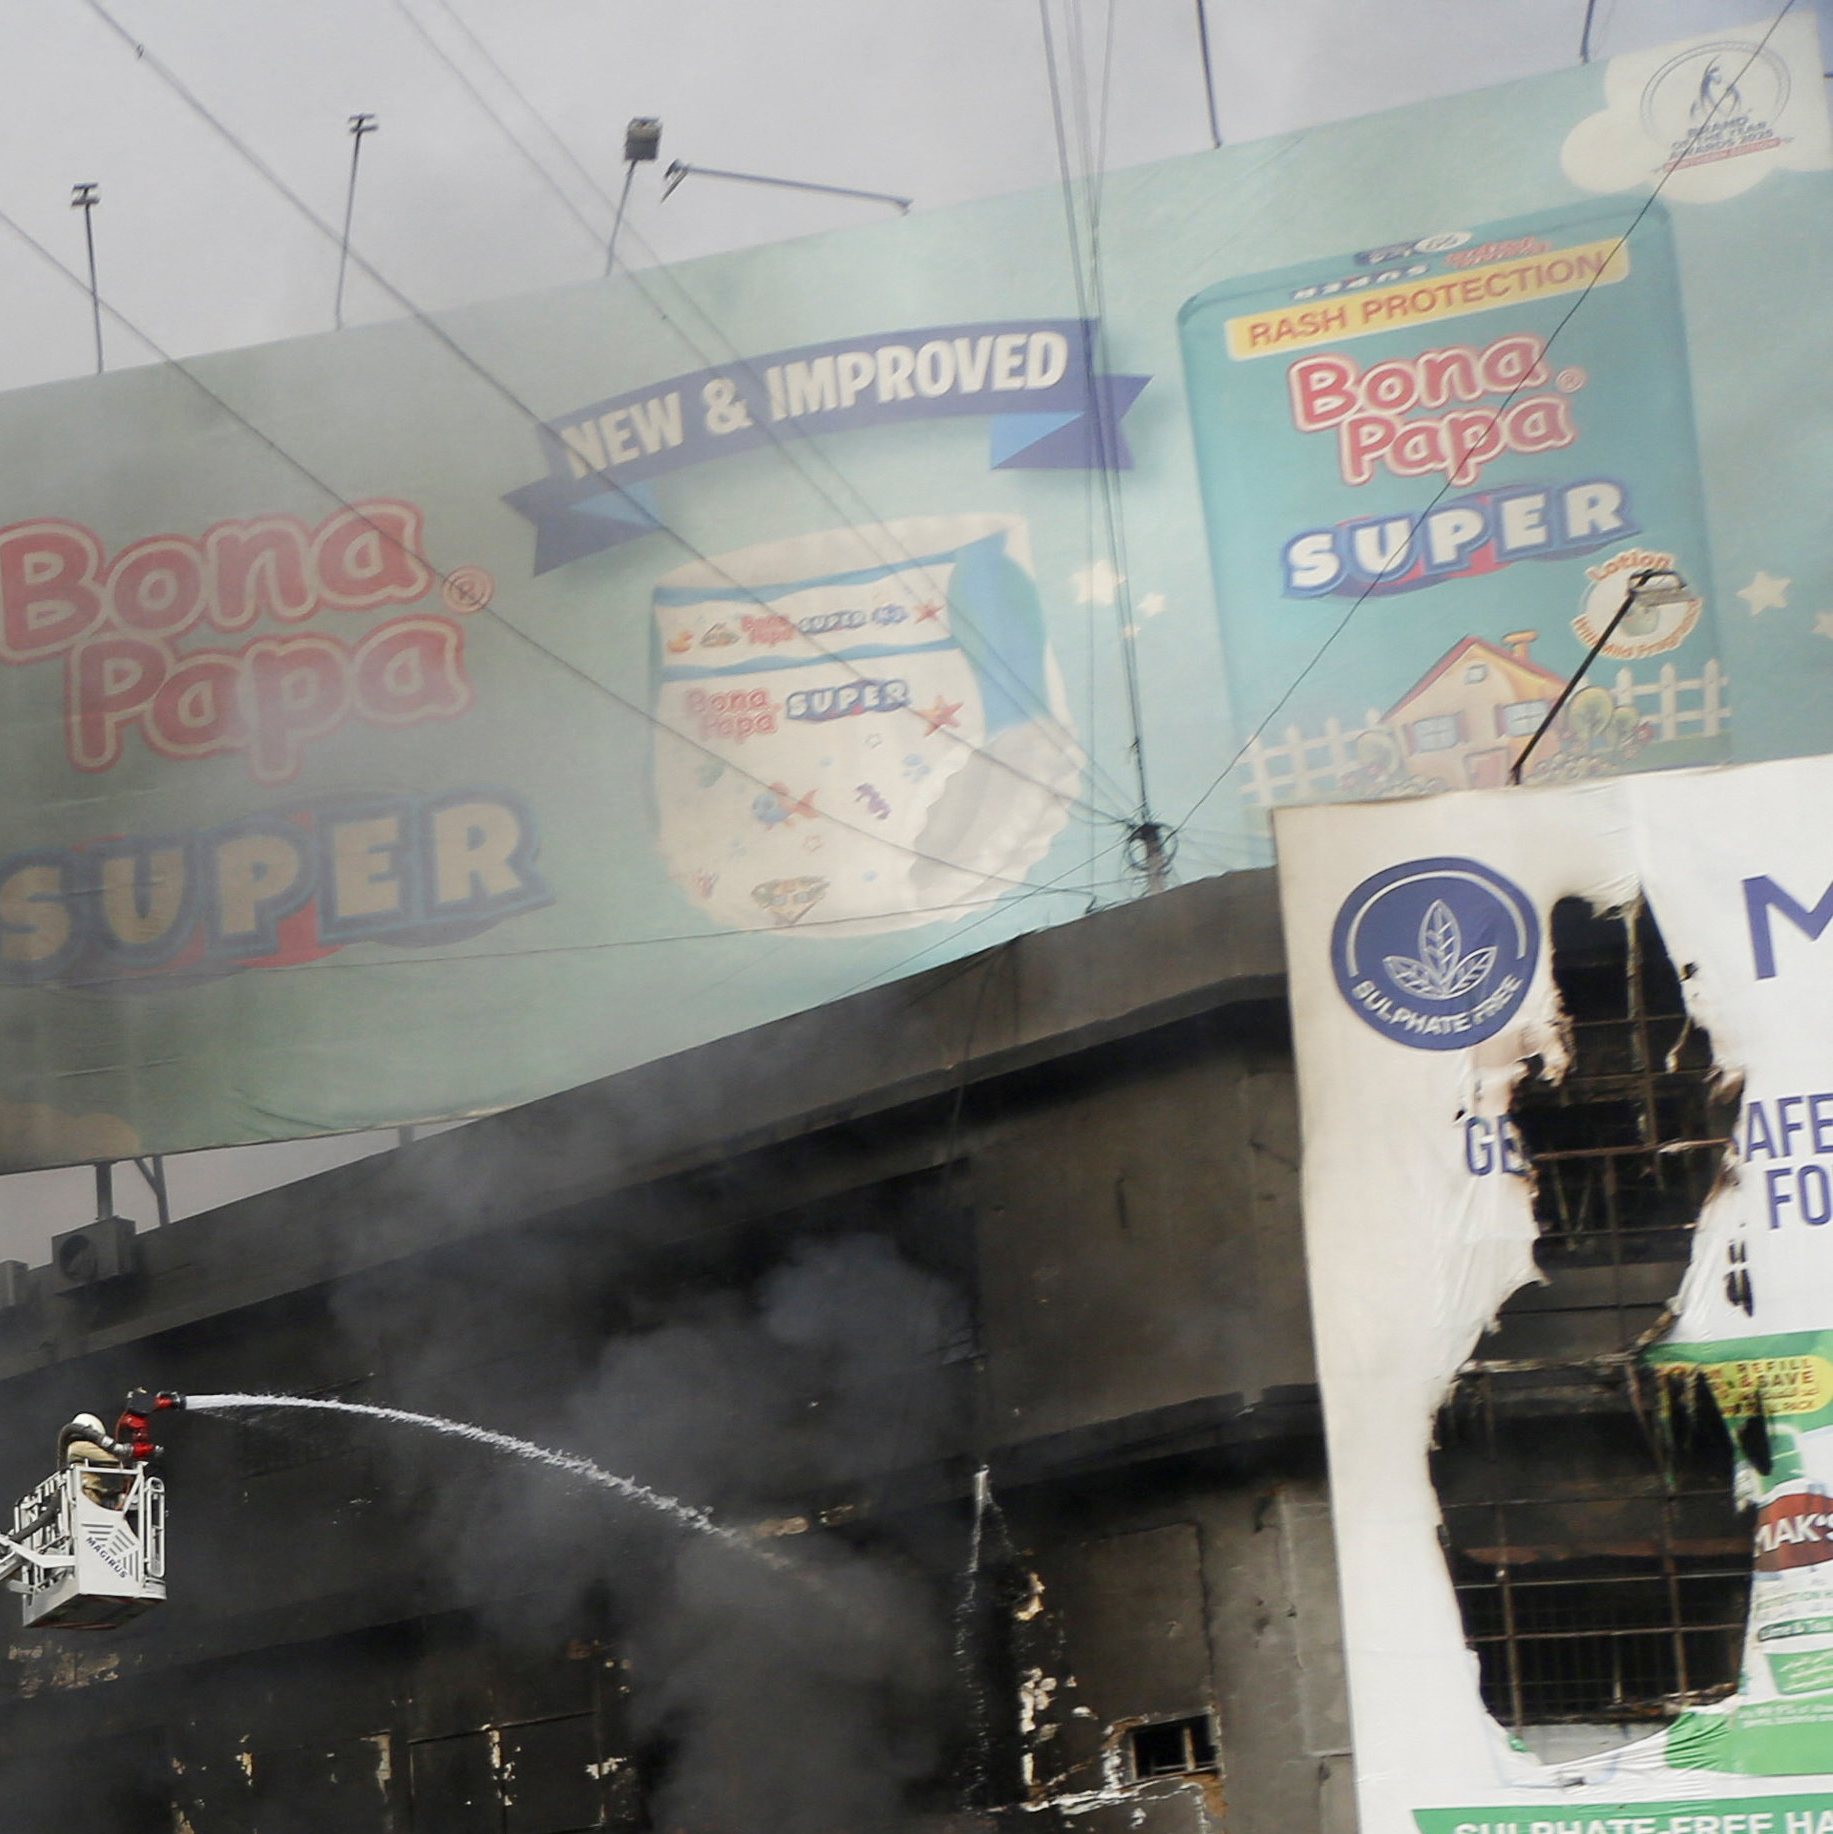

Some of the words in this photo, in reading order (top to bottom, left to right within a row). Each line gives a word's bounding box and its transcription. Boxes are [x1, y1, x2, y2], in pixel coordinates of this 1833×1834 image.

[1249, 306, 1348, 348] RASH
[1361, 250, 1606, 325] PROTECTION
[560, 392, 684, 480] NEW
[701, 378, 751, 435] &
[766, 330, 1069, 422] IMPROVED
[1288, 333, 1551, 433] Bona
[1339, 393, 1578, 488] Papa
[1286, 481, 1624, 589] SUPER
[1585, 549, 1676, 582] Lotion
[65, 614, 476, 785] Papa
[789, 681, 910, 720] SUPER
[1352, 980, 1473, 1036] SULPHATE
[1473, 973, 1523, 1024] FREE
[1756, 1370, 1815, 1389] SAVE
